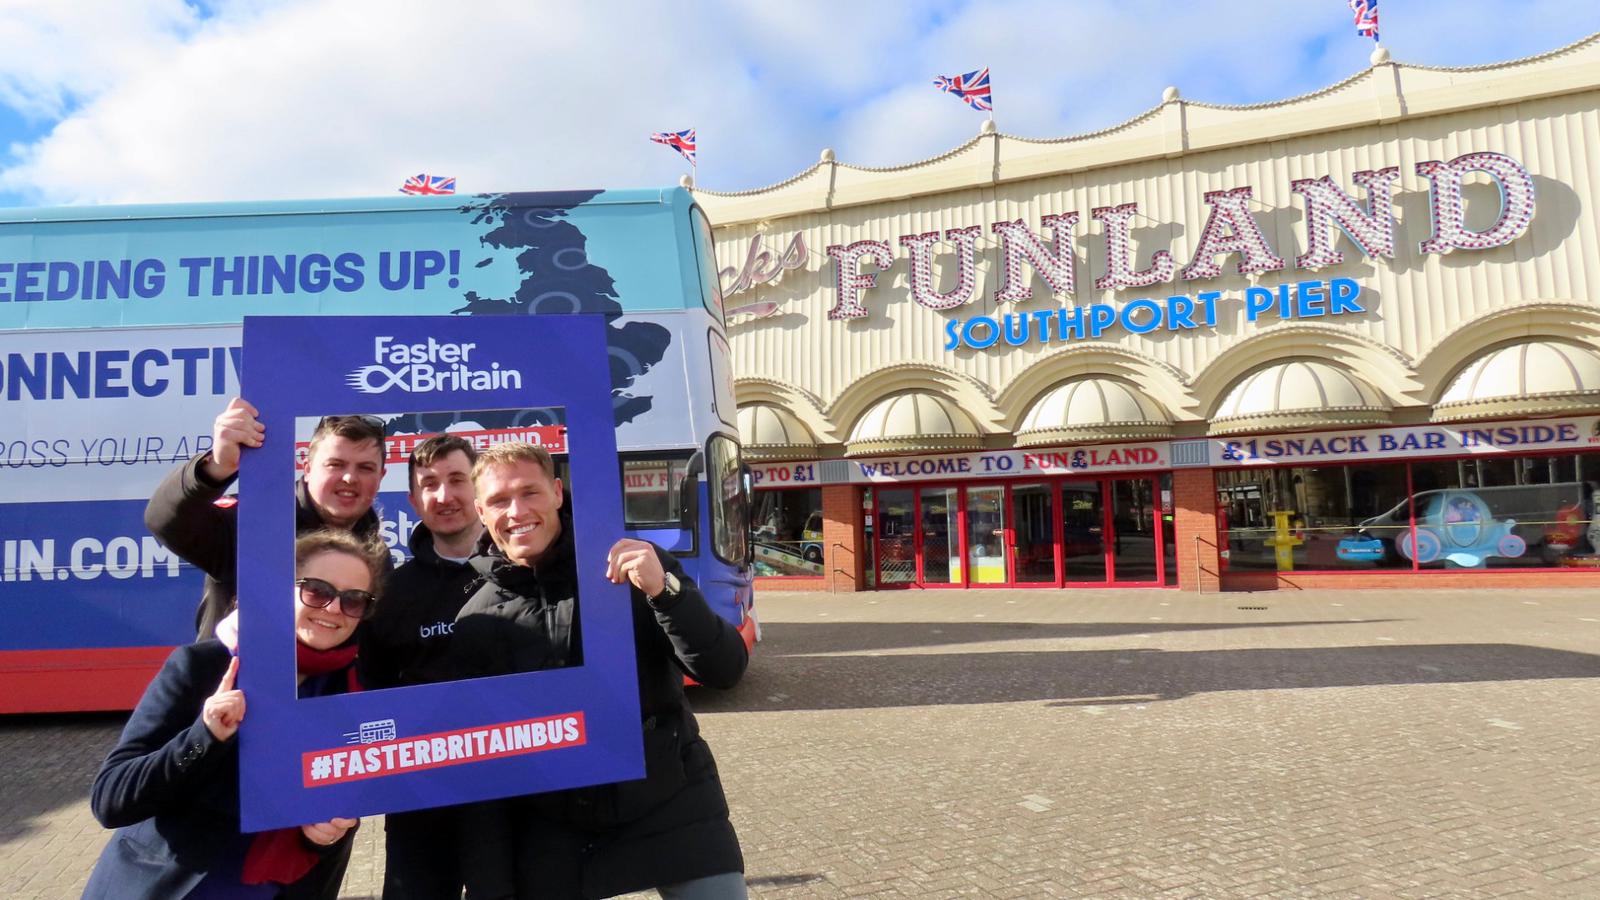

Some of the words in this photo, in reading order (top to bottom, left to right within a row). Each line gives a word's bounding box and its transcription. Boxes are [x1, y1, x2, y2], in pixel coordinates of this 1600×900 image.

[826, 151, 1536, 321] FUNLAND
[180, 253, 365, 297] THINGS
[379, 250, 461, 291] UP!
[945, 291, 1222, 352] SOUTHPORT
[1245, 277, 1367, 323] PIER
[375, 336, 476, 364] Faster
[0, 347, 242, 401] NNECTI
[411, 362, 522, 393] Britain
[0, 439, 70, 469] OSS
[81, 436, 164, 467] YOUR
[1378, 432, 1446, 451] BAR
[1459, 424, 1580, 448] INSIDE
[751, 470, 764, 483] P
[766, 467, 791, 482] TO
[793, 463, 815, 482] £1
[860, 457, 971, 477] WELCOME
[979, 455, 1013, 471] TO
[0, 536, 180, 582] IN.COM
[311, 717, 579, 781] #FASTERBRITAINBUS
